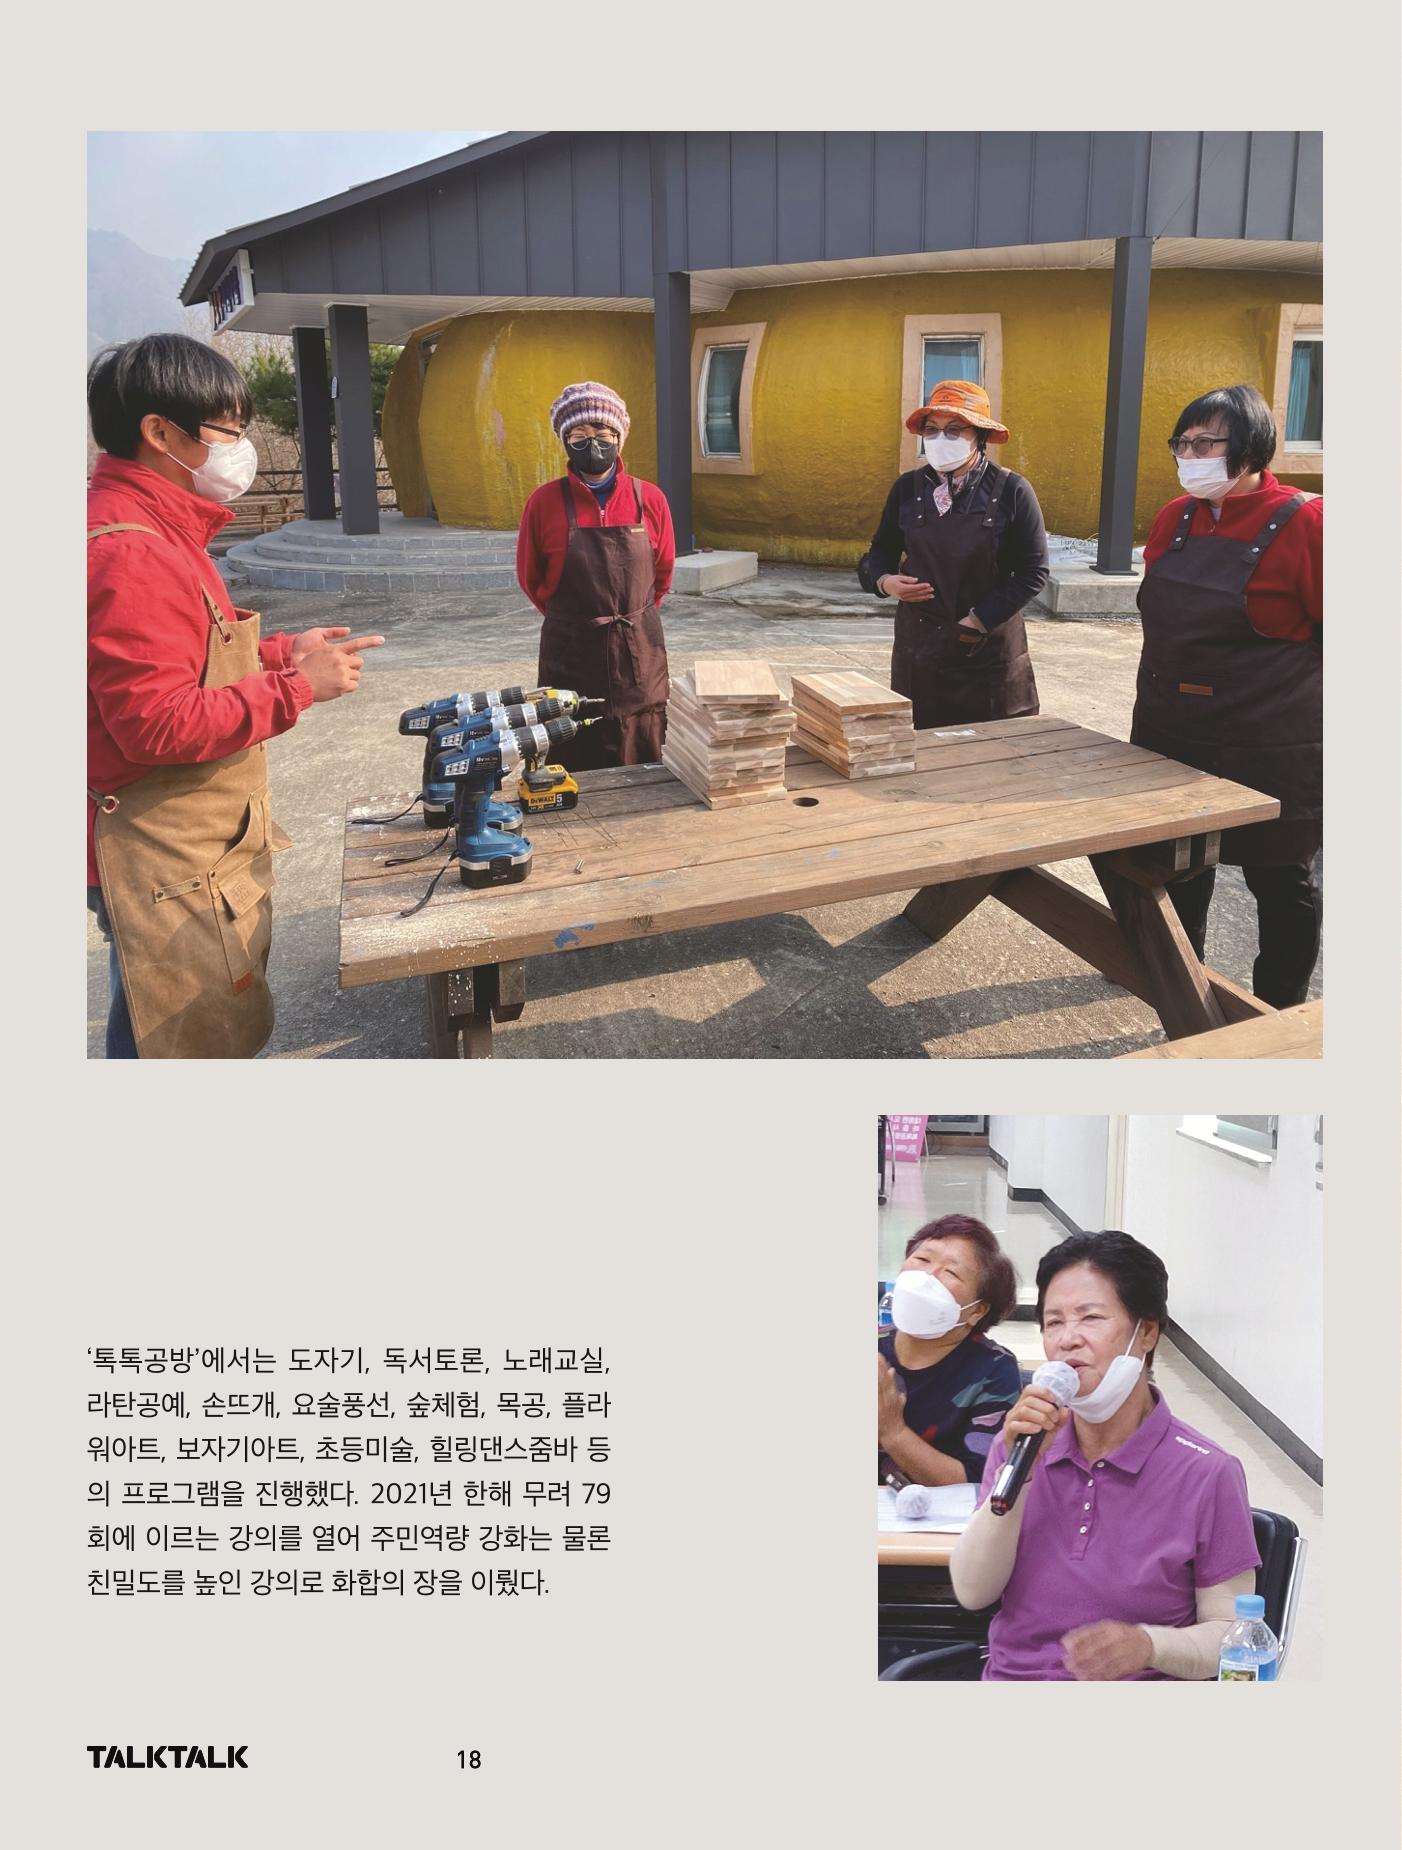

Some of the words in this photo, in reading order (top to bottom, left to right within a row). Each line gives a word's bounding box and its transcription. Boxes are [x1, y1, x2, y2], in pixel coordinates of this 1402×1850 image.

[556, 793, 563, 802] 5
[87, 1346, 277, 1375] ‘톡톡공방’에서는
[288, 1346, 370, 1375] 도자기,
[383, 1346, 490, 1375] 독서토론,
[503, 1346, 610, 1375] 노래교실,
[87, 1391, 191, 1419] 라탄공예,
[201, 1391, 281, 1419] 손뜨개,
[291, 1391, 396, 1419] 요술풍선,
[406, 1391, 486, 1419] 숲체험,
[496, 1392, 551, 1419] 목공,
[561, 1391, 612, 1419] 플라
[86, 1435, 166, 1464] 워아트,
[176, 1435, 305, 1464] 보자기아트,
[315, 1435, 419, 1464] 초등미술,
[429, 1435, 579, 1463] 힐링댄스줌바
[586, 1436, 612, 1463] 등
[87, 1479, 110, 1508] 의
[121, 1479, 245, 1508] 프로그램을
[255, 1479, 359, 1508] 진행했다.
[370, 1479, 452, 1507] 2021년
[463, 1479, 511, 1508] 한해
[522, 1479, 570, 1508] 무려
[581, 1482, 611, 1505] 79
[87, 1524, 135, 1552] 회에
[146, 1524, 220, 1552] 이르는
[229, 1524, 303, 1552] 강의를
[312, 1524, 360, 1552] 열어
[370, 1524, 470, 1552] 주민역량
[479, 1524, 553, 1552] 강화는
[561, 1525, 612, 1552] 물론
[87, 1568, 186, 1597] 친밀도를
[193, 1568, 241, 1596] 높인
[250, 1568, 325, 1597] 강의로
[331, 1568, 404, 1597] 화합의
[413, 1568, 463, 1597] 장을
[471, 1568, 549, 1597] 이뤘다.
[86, 1745, 249, 1769] TALKTALK
[457, 1749, 482, 1770] 18
